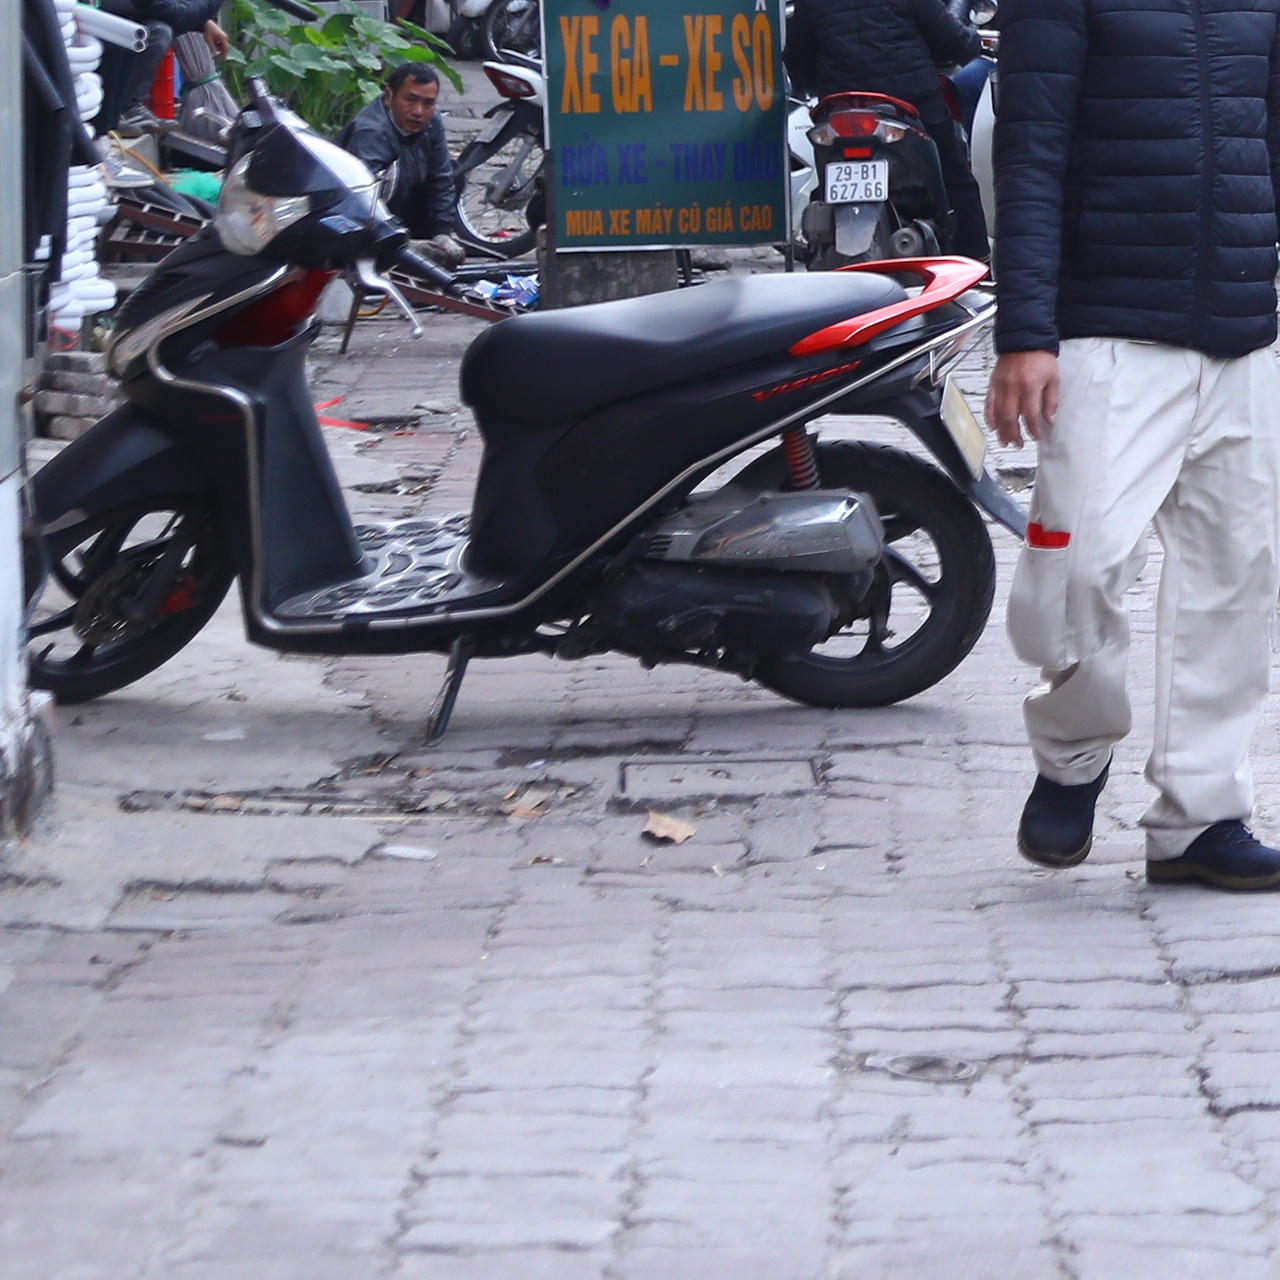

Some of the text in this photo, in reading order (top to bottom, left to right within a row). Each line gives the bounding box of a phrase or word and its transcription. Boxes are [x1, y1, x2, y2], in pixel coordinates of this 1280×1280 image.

[560, 16, 600, 113] XE
[610, 14, 653, 114] GA
[683, 15, 723, 112] XE
[617, 144, 648, 185] XE
[835, 163, 877, 182] 29-B1
[830, 182, 883, 200] 627.66
[565, 200, 773, 236] MUA XE MÁY CŨ GIÁ CAO
